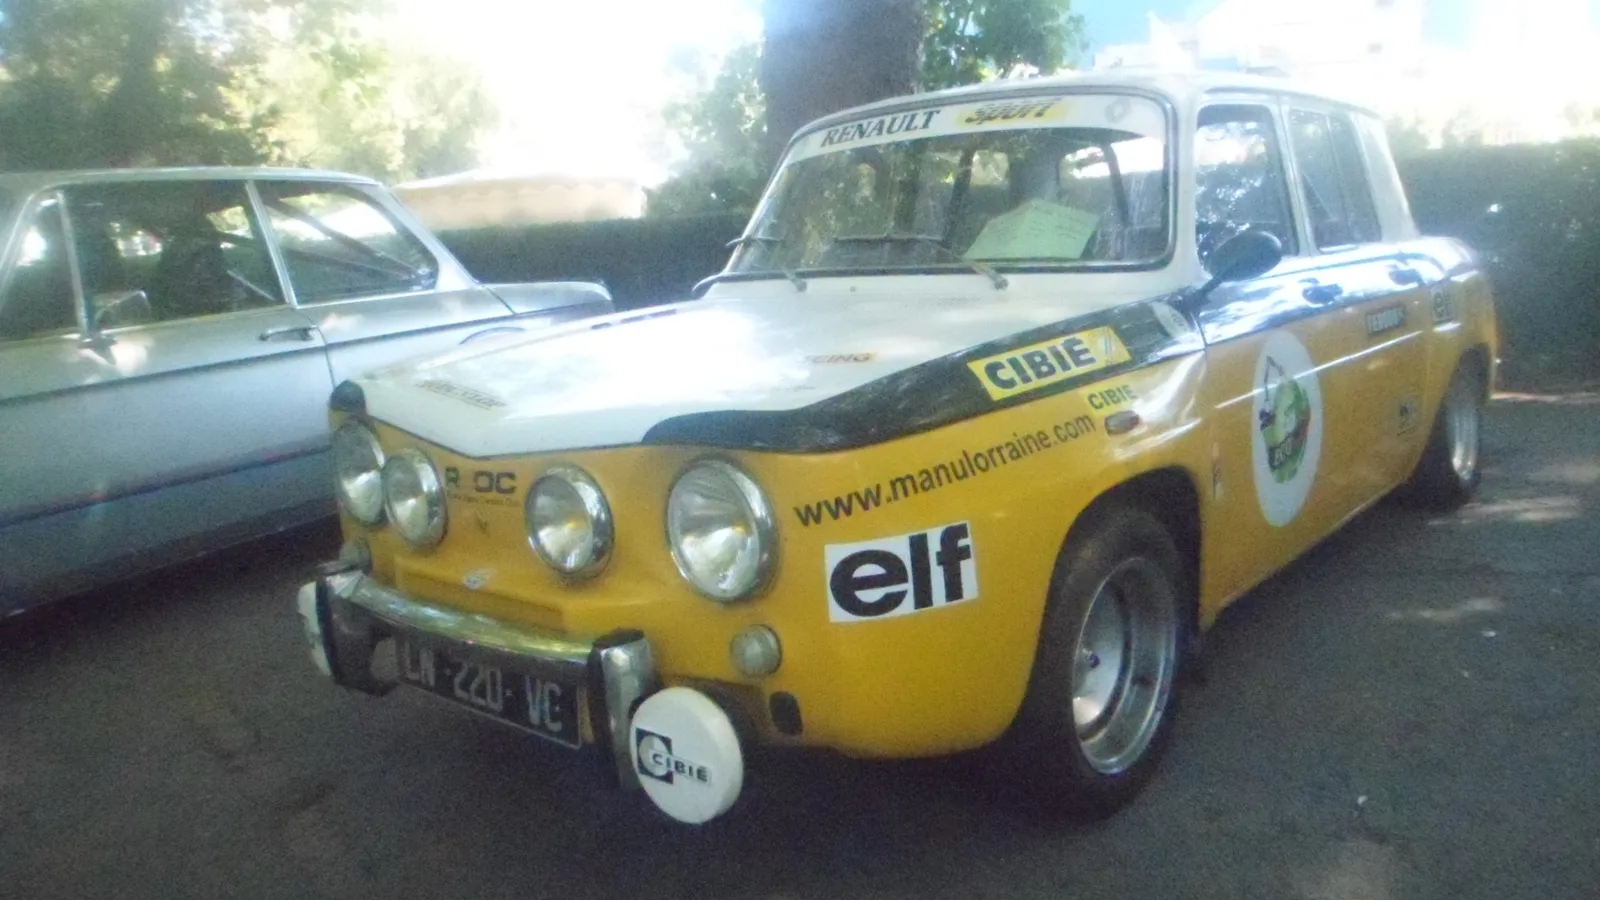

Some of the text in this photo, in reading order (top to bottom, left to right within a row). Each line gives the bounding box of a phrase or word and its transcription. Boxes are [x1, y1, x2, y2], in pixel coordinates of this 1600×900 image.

[820, 110, 940, 148] RENAULT
[793, 411, 1096, 527] www.manulorraine.com
[829, 522, 972, 617] elf
[449, 655, 503, 712] 220
[525, 674, 564, 733] VC
